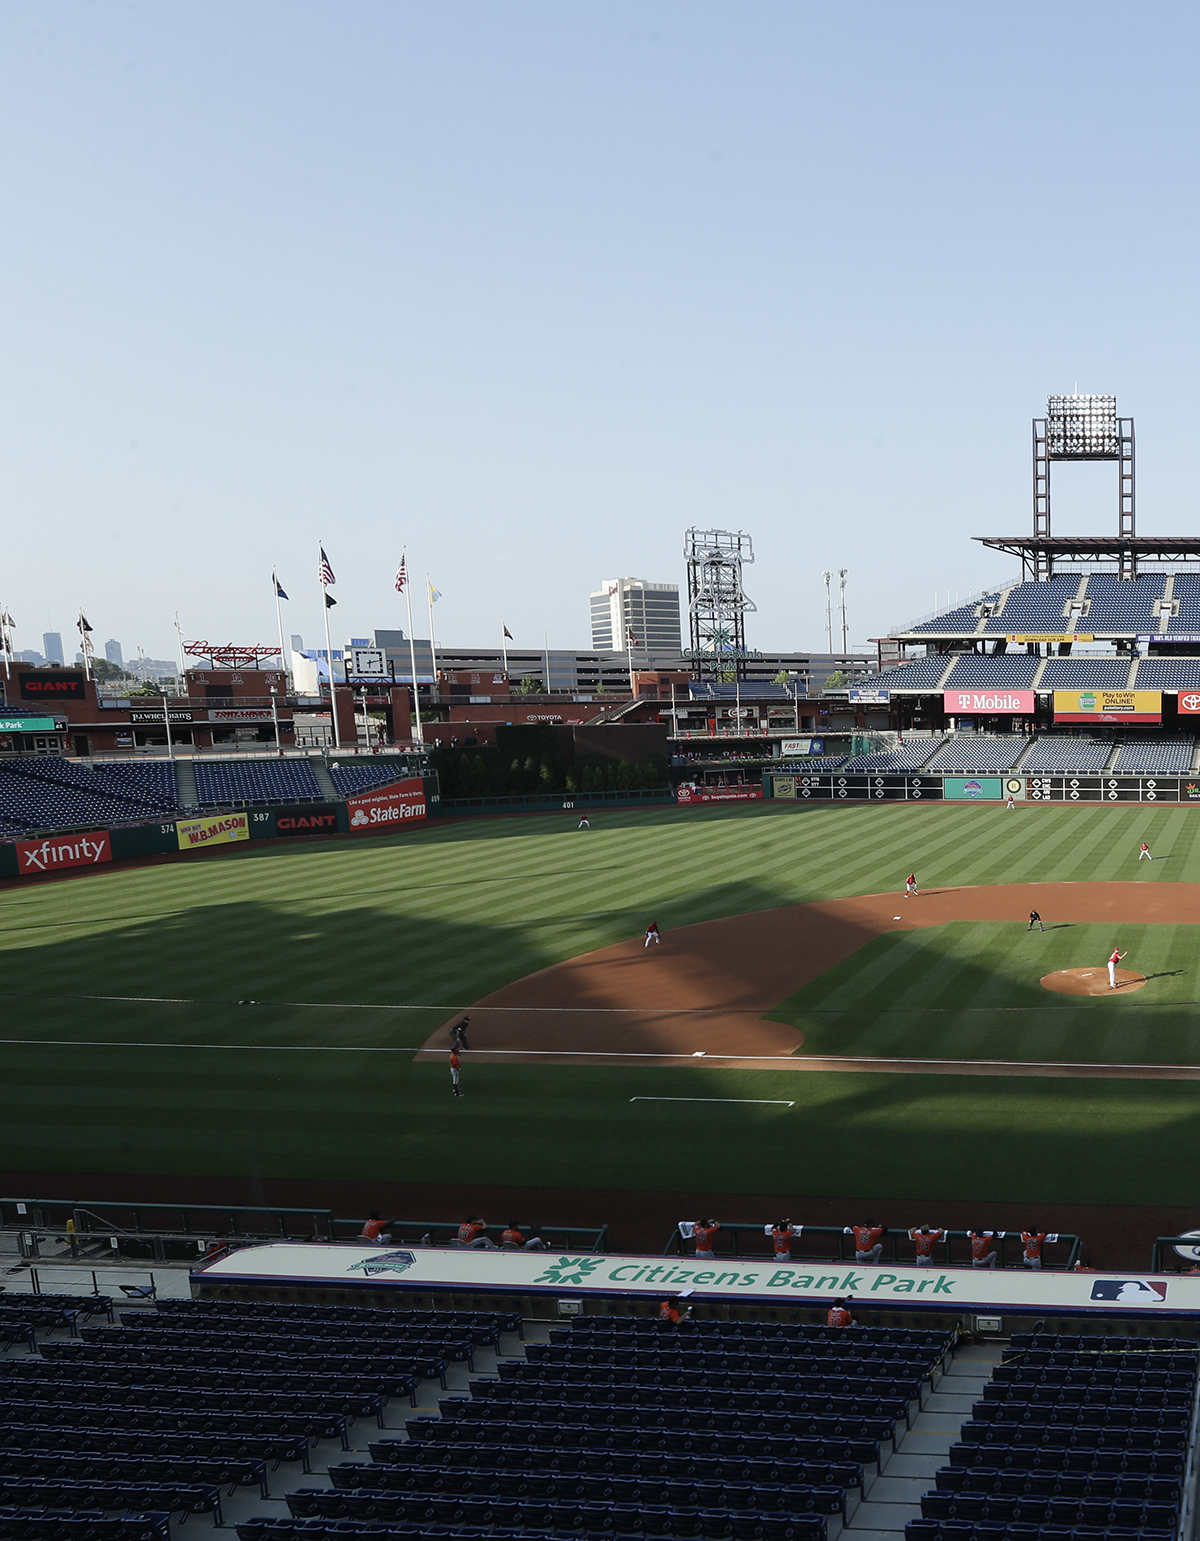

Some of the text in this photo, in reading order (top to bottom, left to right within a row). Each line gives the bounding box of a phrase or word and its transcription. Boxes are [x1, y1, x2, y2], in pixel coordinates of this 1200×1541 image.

[683, 648, 761, 658] Citizens Bank
[710, 661, 736, 671] Park
[25, 682, 78, 691] GIANT
[973, 694, 1021, 710] Mobile
[253, 813, 269, 821] 387
[277, 815, 335, 829] GIANT
[161, 825, 174, 833] 374
[24, 838, 105, 869] xfinity
[608, 1264, 956, 1294] Citizens Bank Park
